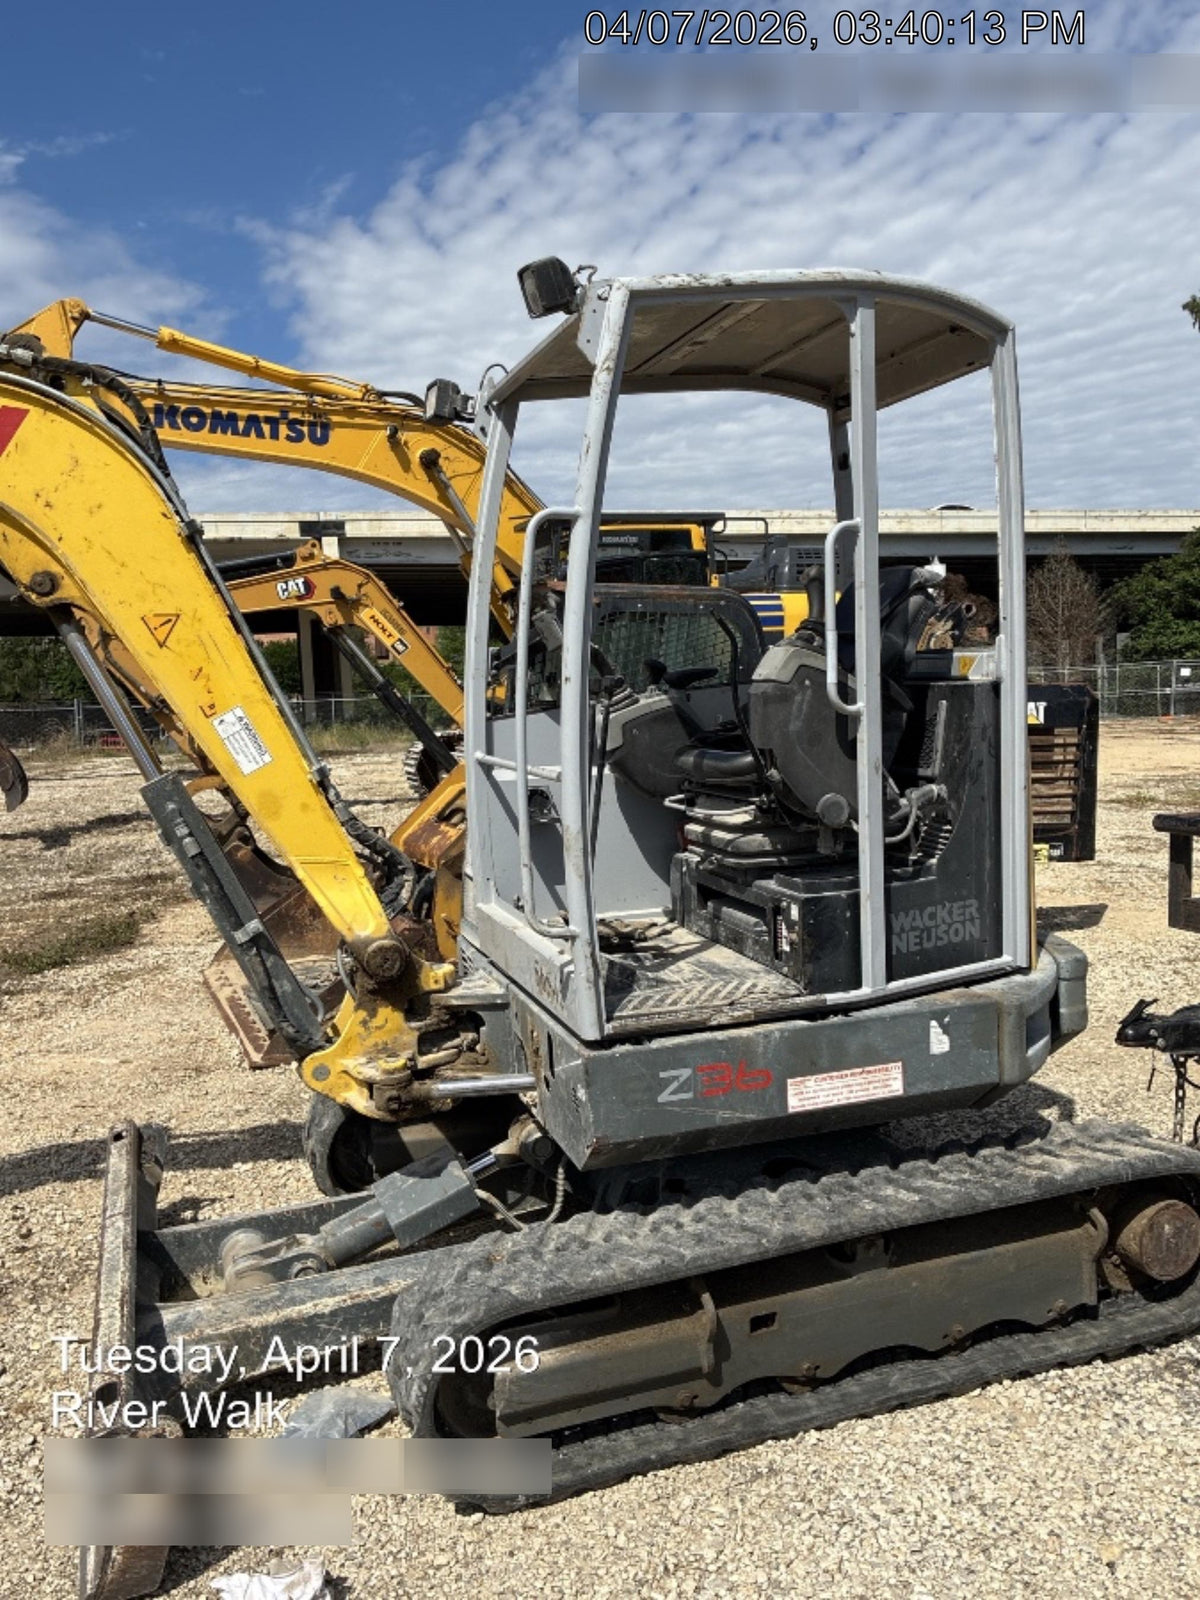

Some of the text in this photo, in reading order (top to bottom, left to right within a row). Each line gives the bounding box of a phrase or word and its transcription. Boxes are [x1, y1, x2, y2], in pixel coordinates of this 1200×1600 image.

[153, 403, 332, 447] KOMATSU
[277, 577, 305, 600] CAT
[369, 614, 396, 639] HOLT
[1027, 702, 1048, 724] AT
[890, 899, 980, 934] WACKER
[892, 919, 980, 956] NEUSON
[657, 1059, 773, 1103] Z36
